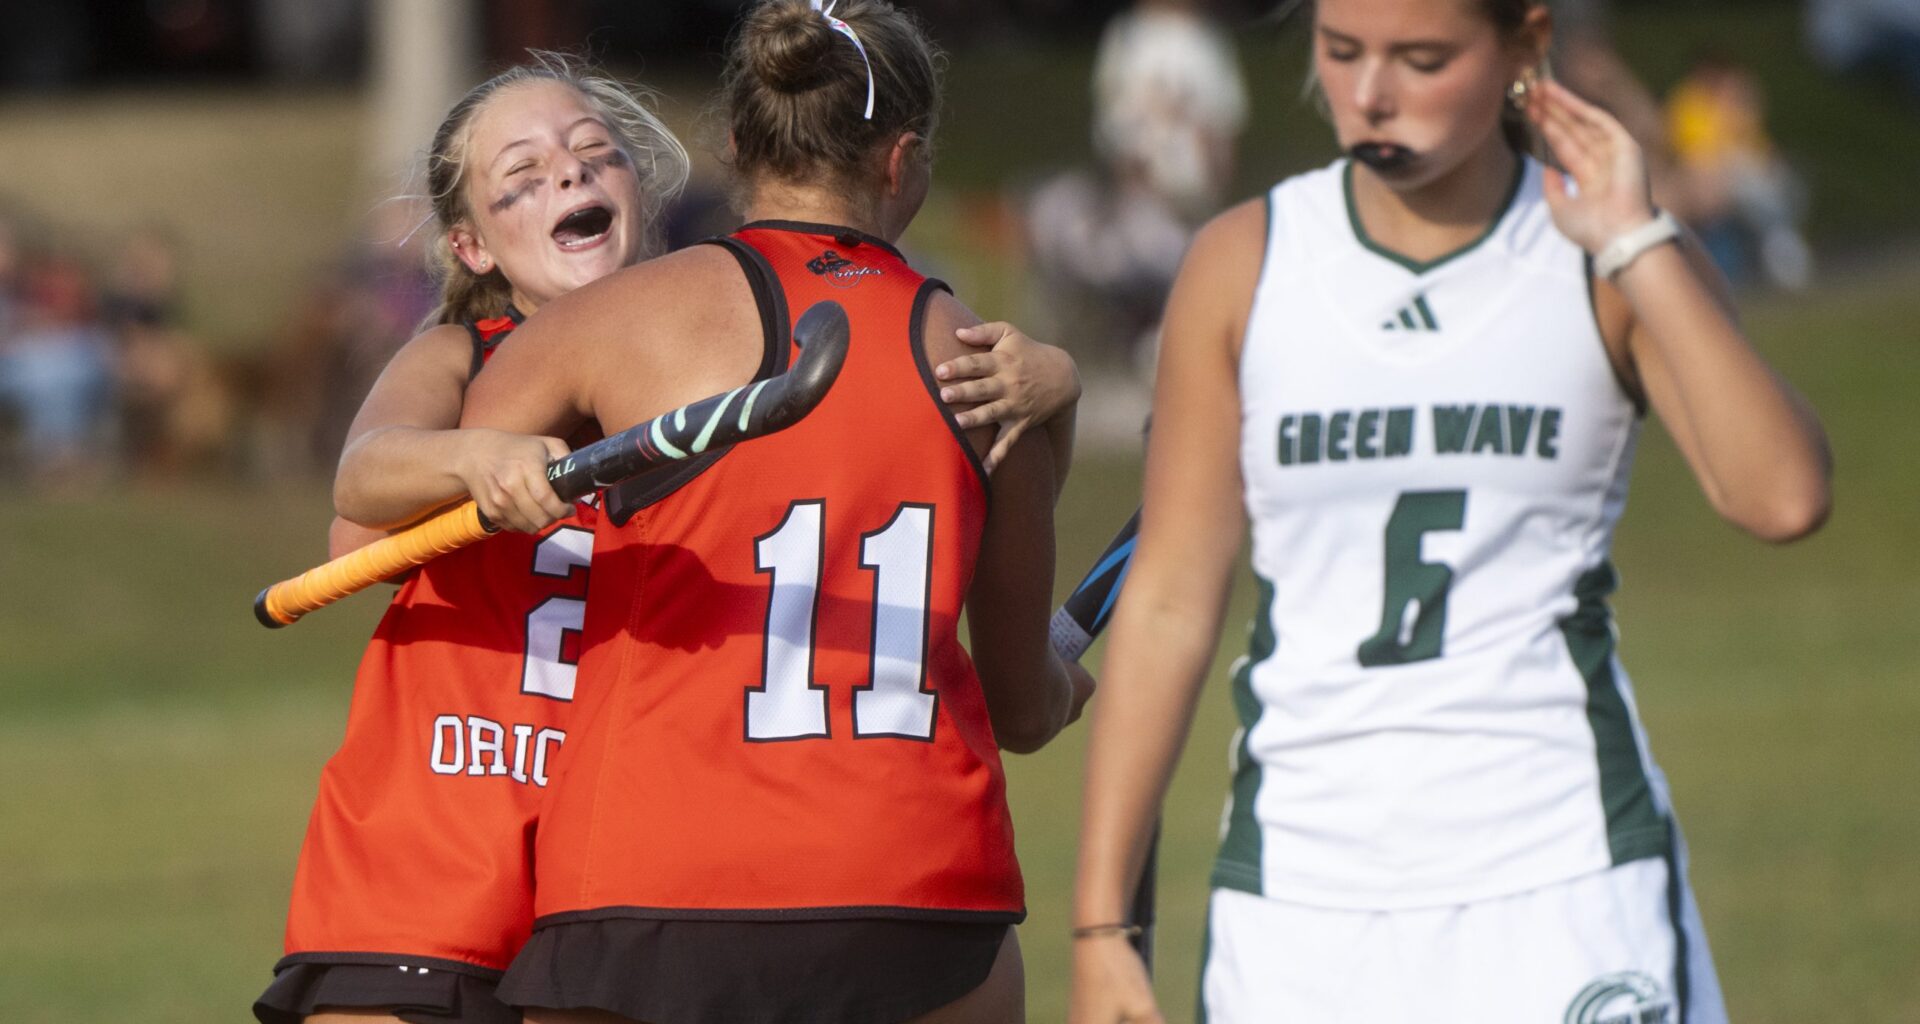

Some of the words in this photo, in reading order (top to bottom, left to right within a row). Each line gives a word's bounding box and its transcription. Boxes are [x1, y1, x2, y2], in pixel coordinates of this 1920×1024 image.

[1277, 404, 1416, 467] GREEN
[1431, 401, 1563, 460] WAVE
[743, 497, 939, 743] 11
[1356, 487, 1468, 668] 6
